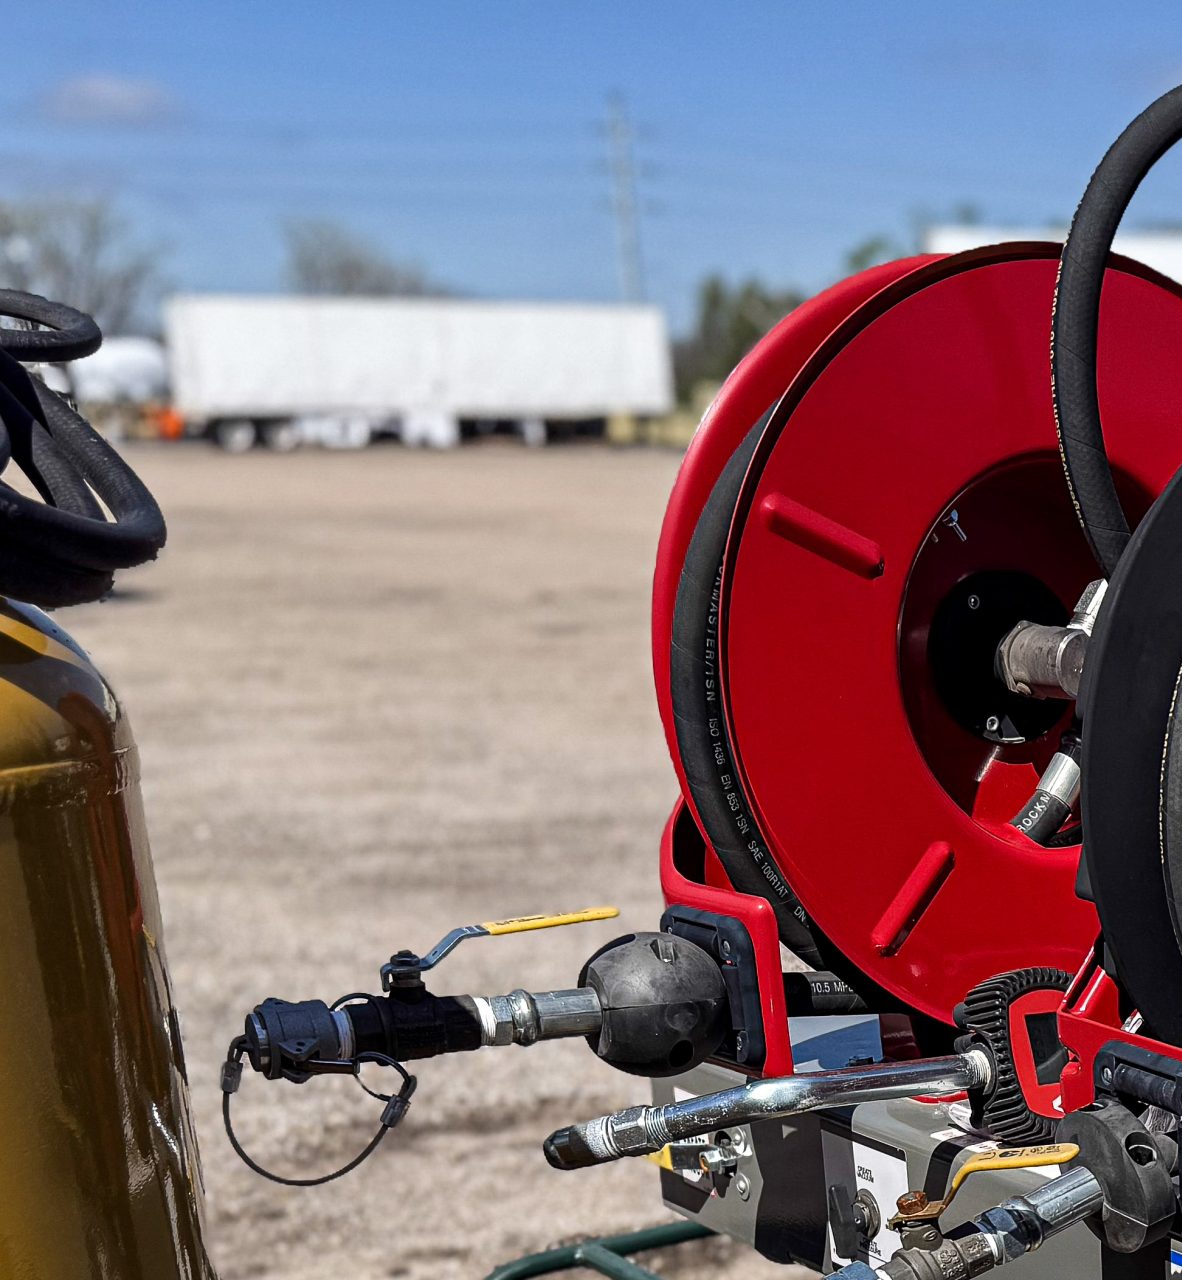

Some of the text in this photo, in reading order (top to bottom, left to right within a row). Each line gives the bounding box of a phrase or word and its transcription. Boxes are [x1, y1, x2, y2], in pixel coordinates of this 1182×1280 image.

[720, 774, 732, 790] EN
[726, 792, 740, 812] 853
[747, 840, 763, 863] SAE
[760, 861, 789, 899] 100R1AT
[810, 982, 831, 993] 10.5
